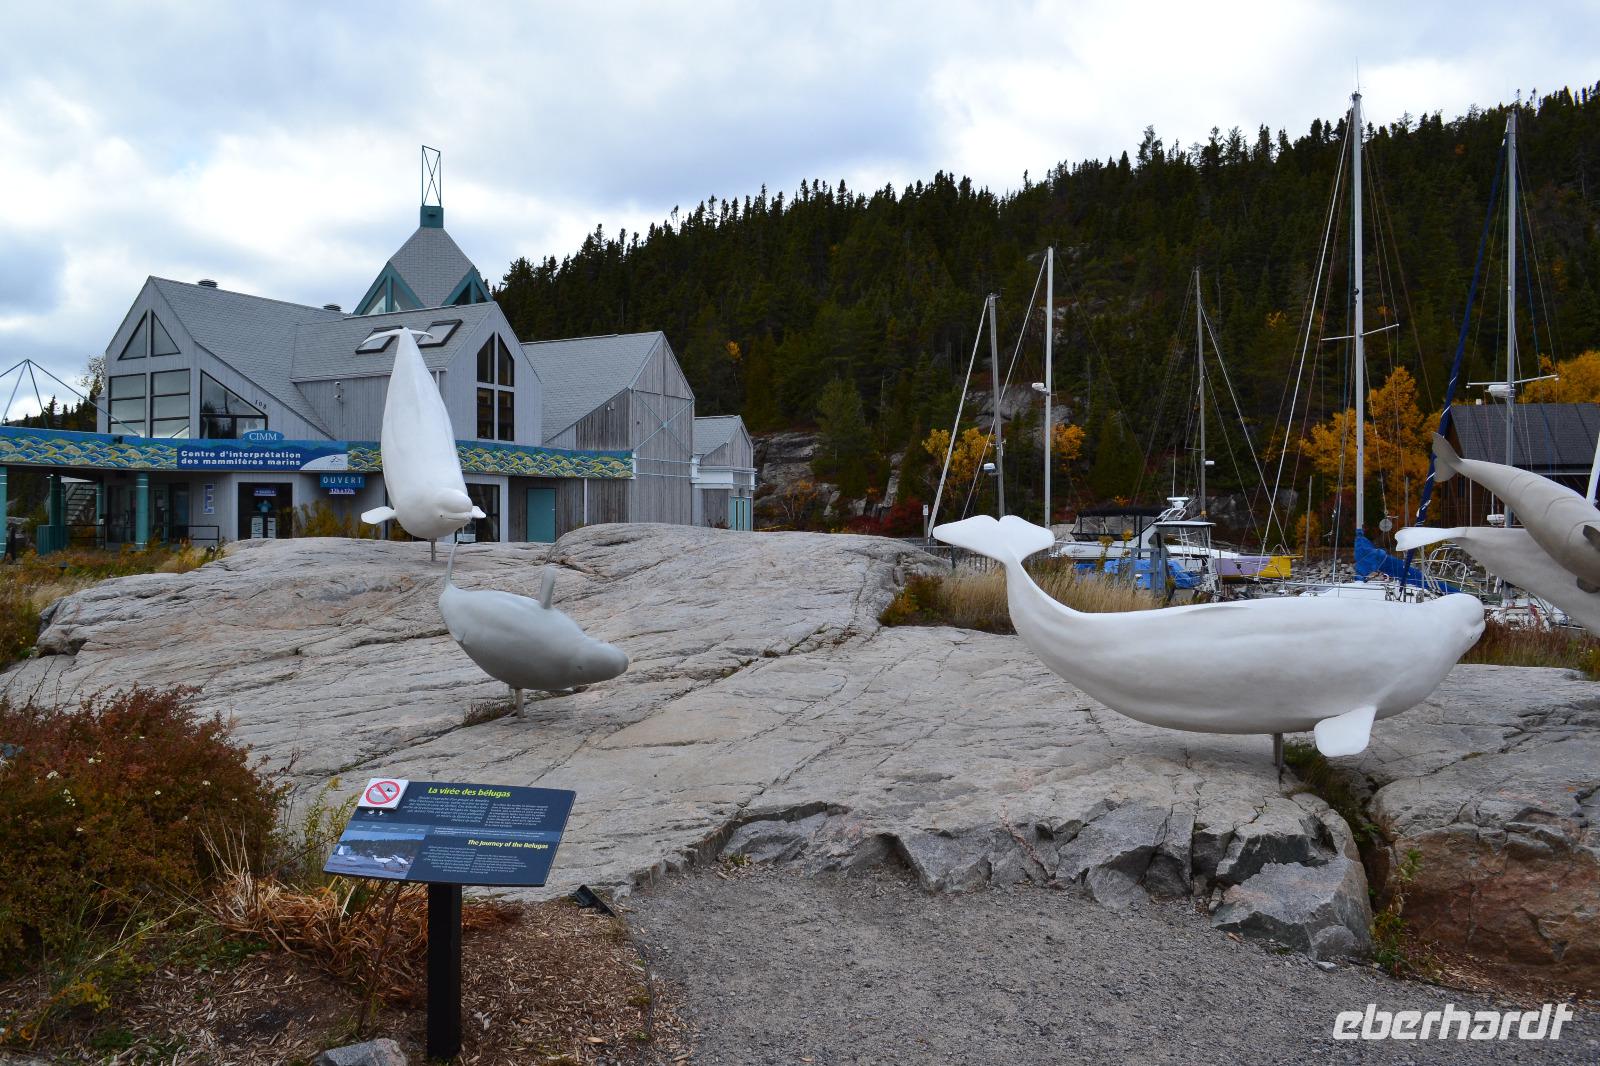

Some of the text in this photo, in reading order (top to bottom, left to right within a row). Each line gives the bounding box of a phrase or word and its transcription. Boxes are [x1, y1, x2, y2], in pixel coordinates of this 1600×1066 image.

[249, 432, 277, 441] CIMM
[181, 450, 301, 459] Centre d'interprétation
[181, 457, 199, 465] des
[267, 459, 301, 467] marins
[323, 476, 362, 484] OUVERT
[440, 787, 460, 795] virée
[461, 788, 476, 796] des
[478, 789, 511, 798] bélugas
[479, 840, 503, 848] Journey
[524, 842, 549, 850] Belugas
